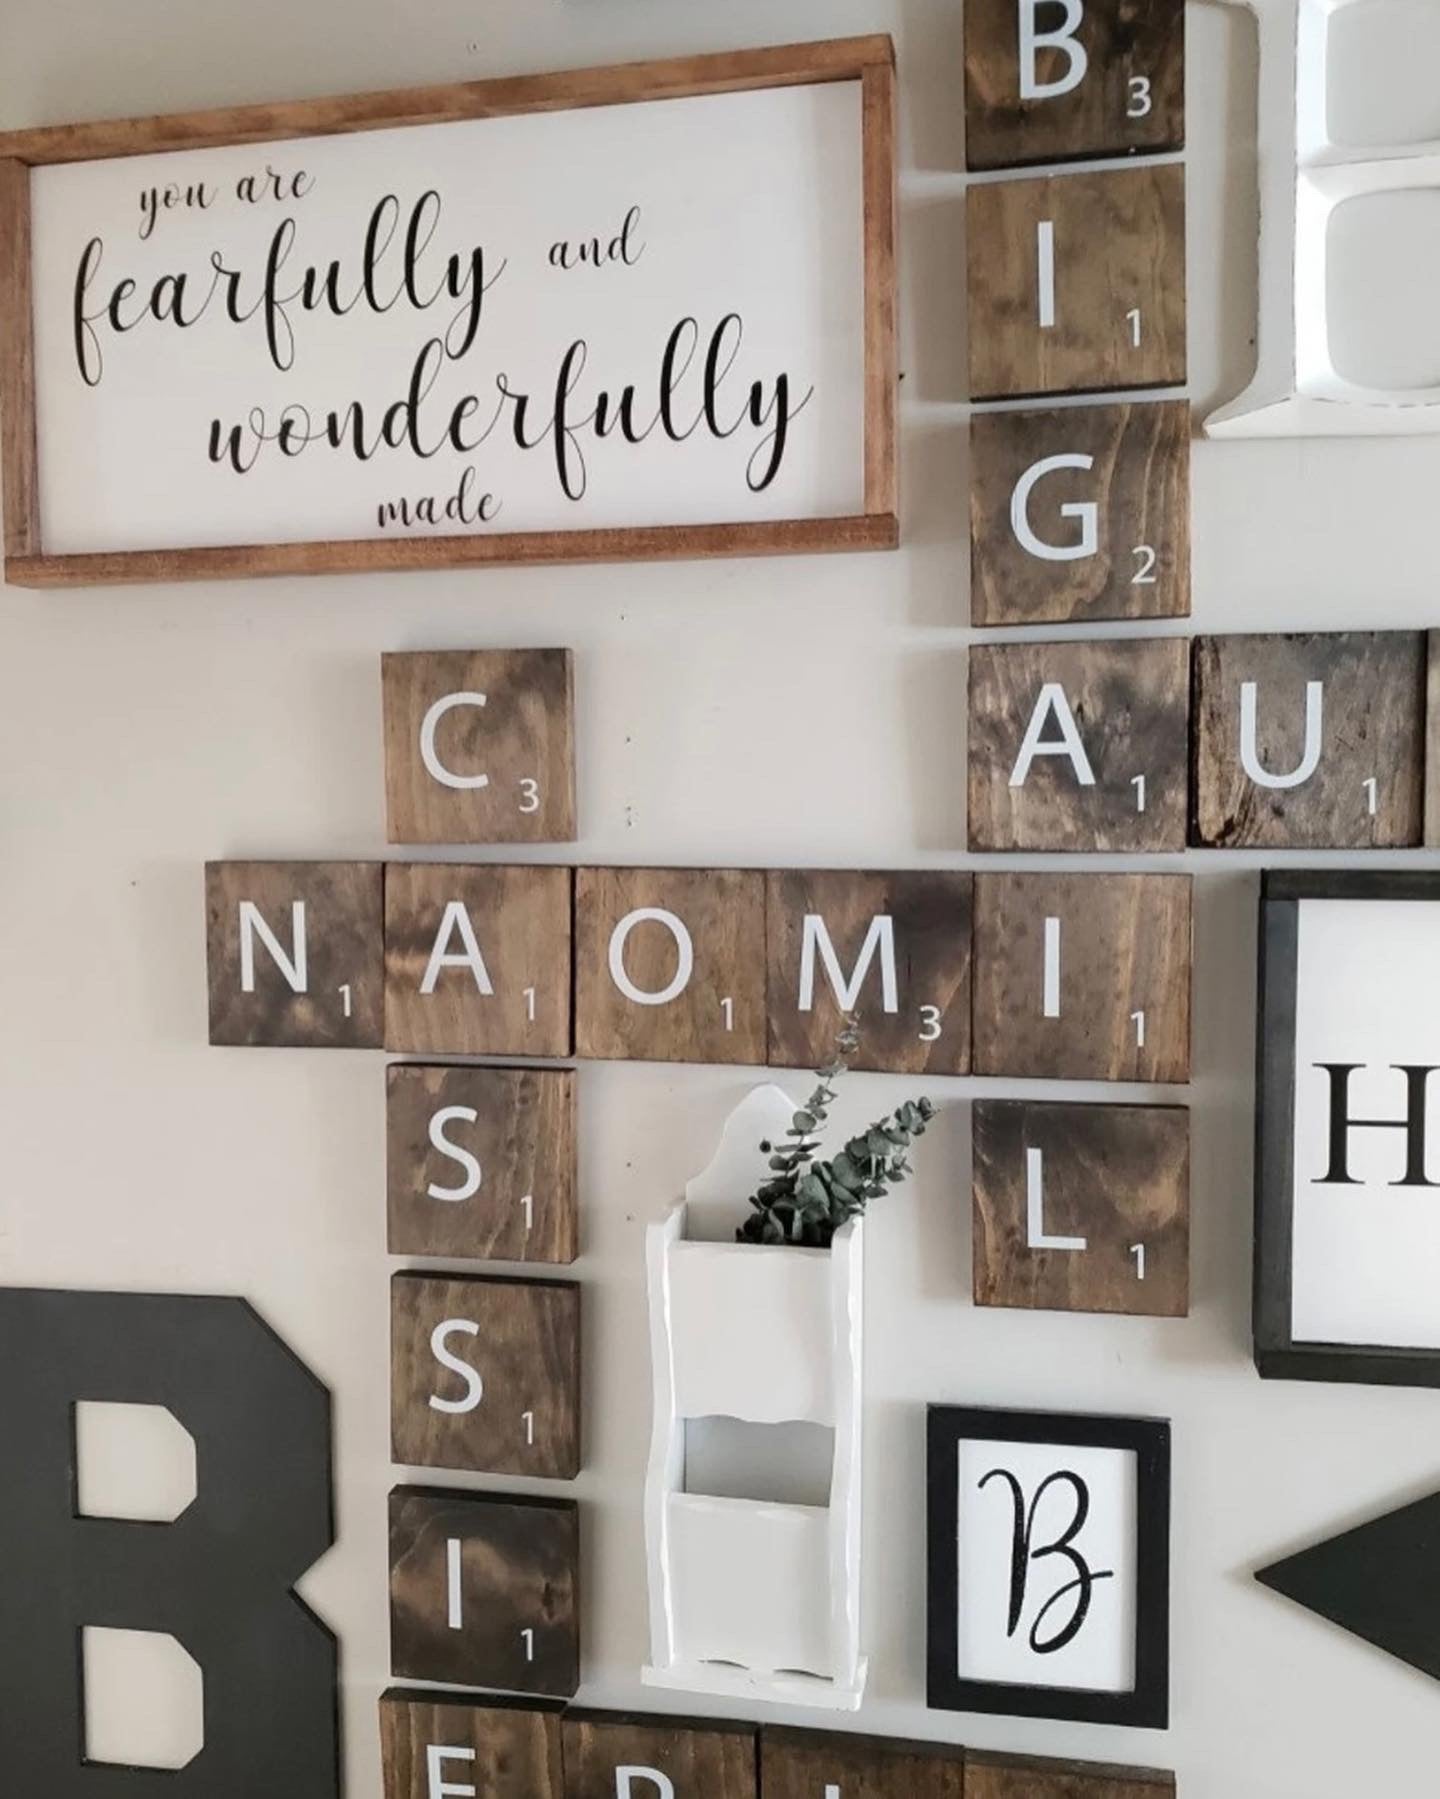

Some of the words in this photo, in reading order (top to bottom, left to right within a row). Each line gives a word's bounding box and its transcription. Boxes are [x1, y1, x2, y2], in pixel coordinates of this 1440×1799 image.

[1018, 0, 1088, 99] B
[1126, 77, 1151, 117] 3
[139, 182, 214, 240] you
[235, 164, 315, 206] are
[74, 189, 507, 388] fearfully
[547, 205, 647, 271] and
[1037, 220, 1055, 328] I
[208, 312, 815, 502] wonderfully
[377, 465, 503, 529] made
[1009, 453, 1099, 561] G
[1130, 544, 1157, 585] 2
[419, 691, 489, 790] C
[518, 777, 540, 813] 3
[1008, 683, 1096, 787] A
[1239, 681, 1324, 789] U
[238, 900, 308, 993] N
[418, 901, 495, 995] A
[607, 906, 694, 1005] O
[797, 913, 899, 1014] M
[918, 1005, 943, 1042] 3
[1043, 916, 1061, 1018] I
[427, 1105, 483, 1202] S
[1026, 1147, 1088, 1250] L
[427, 1318, 484, 1414] S
[446, 1537, 463, 1630] I
[977, 1469, 1114, 1655] B
